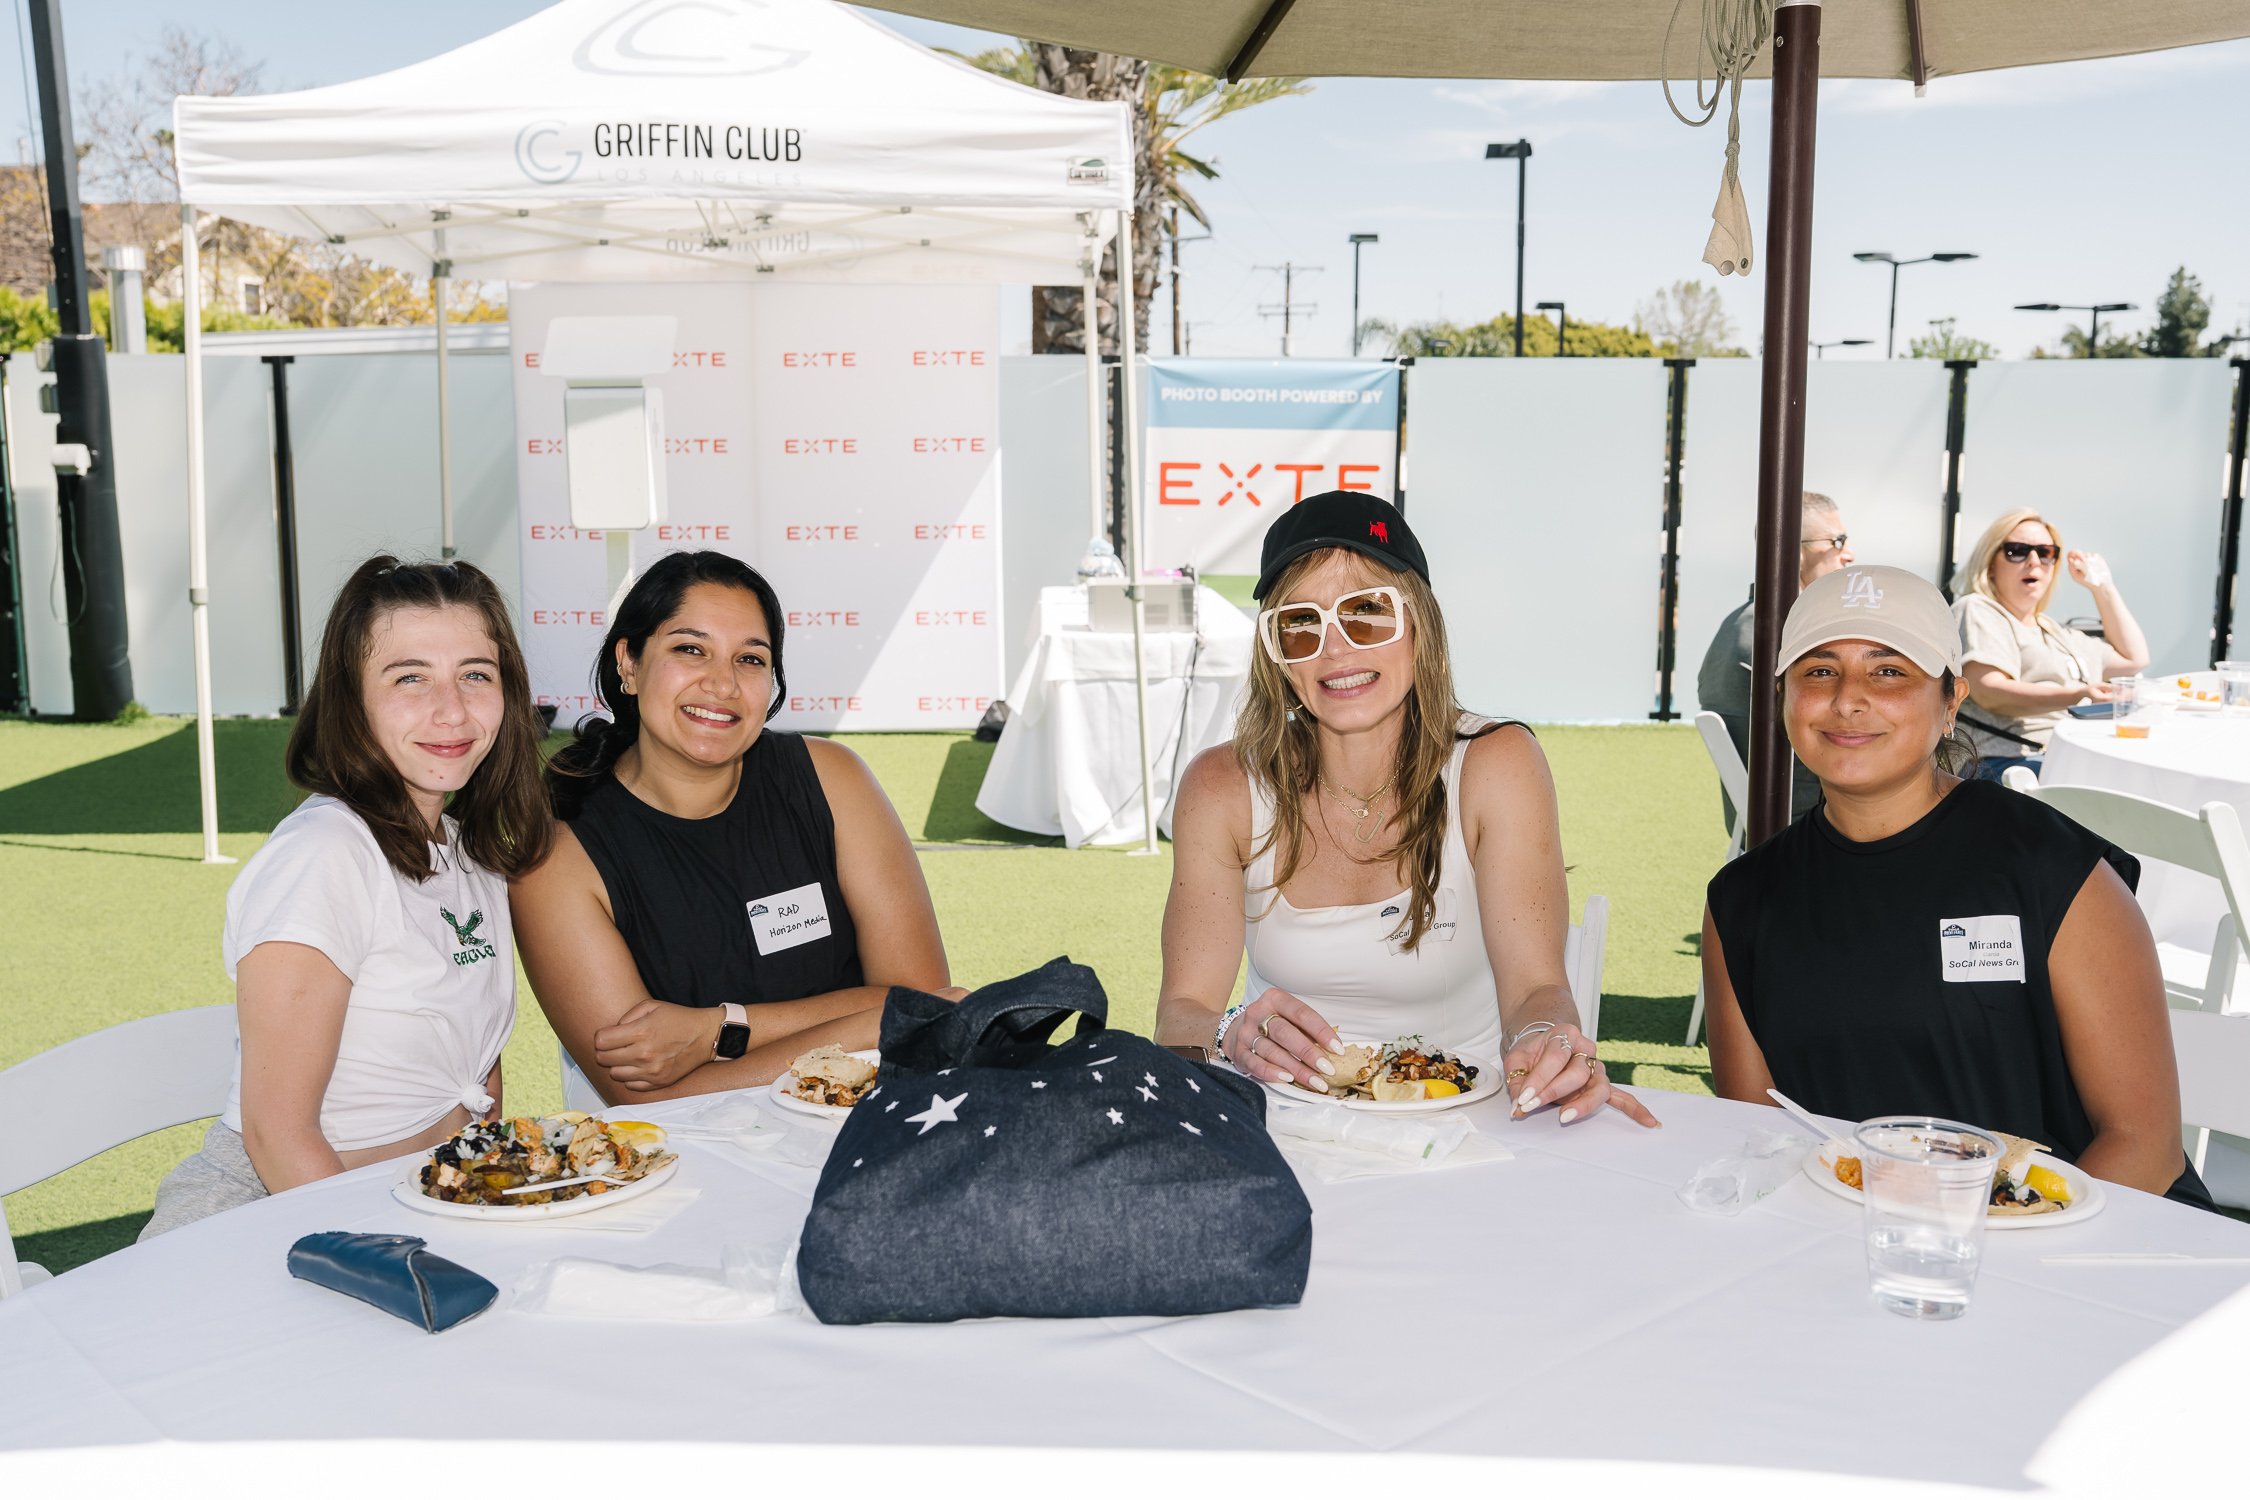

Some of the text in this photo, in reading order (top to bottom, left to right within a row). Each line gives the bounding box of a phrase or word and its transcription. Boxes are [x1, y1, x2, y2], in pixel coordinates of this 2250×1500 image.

[594, 122, 801, 162] GRIFFIN CLUB
[598, 168, 801, 186] LOS ANGELES
[673, 352, 726, 367] XTE
[784, 352, 856, 367] EXTE
[913, 351, 985, 366] EXTE
[1161, 387, 1384, 404] PHOTO BOOTH POWERED BY
[528, 439, 562, 454] EX
[785, 439, 857, 454] EXTE
[913, 437, 985, 452] EXTE
[1160, 462, 1380, 506] EXTE
[531, 525, 603, 540] EXTE
[658, 525, 730, 540] EXTE
[787, 525, 859, 540] EXTE
[914, 525, 986, 539] EXTE
[1841, 571, 1883, 608] LA
[533, 611, 604, 625] EXTE
[788, 612, 860, 626] EXTE
[916, 611, 987, 626] EXTE
[790, 697, 862, 711] EXTE
[918, 697, 989, 711] EXTE
[778, 904, 799, 918] RAD
[770, 923, 801, 938] Horizon
[1390, 930, 1410, 941] SoCal
[1433, 921, 1456, 930] Group
[1969, 940, 2012, 951] Miranda
[1949, 960, 1976, 969] SoCal
[1979, 959, 2003, 967] News
